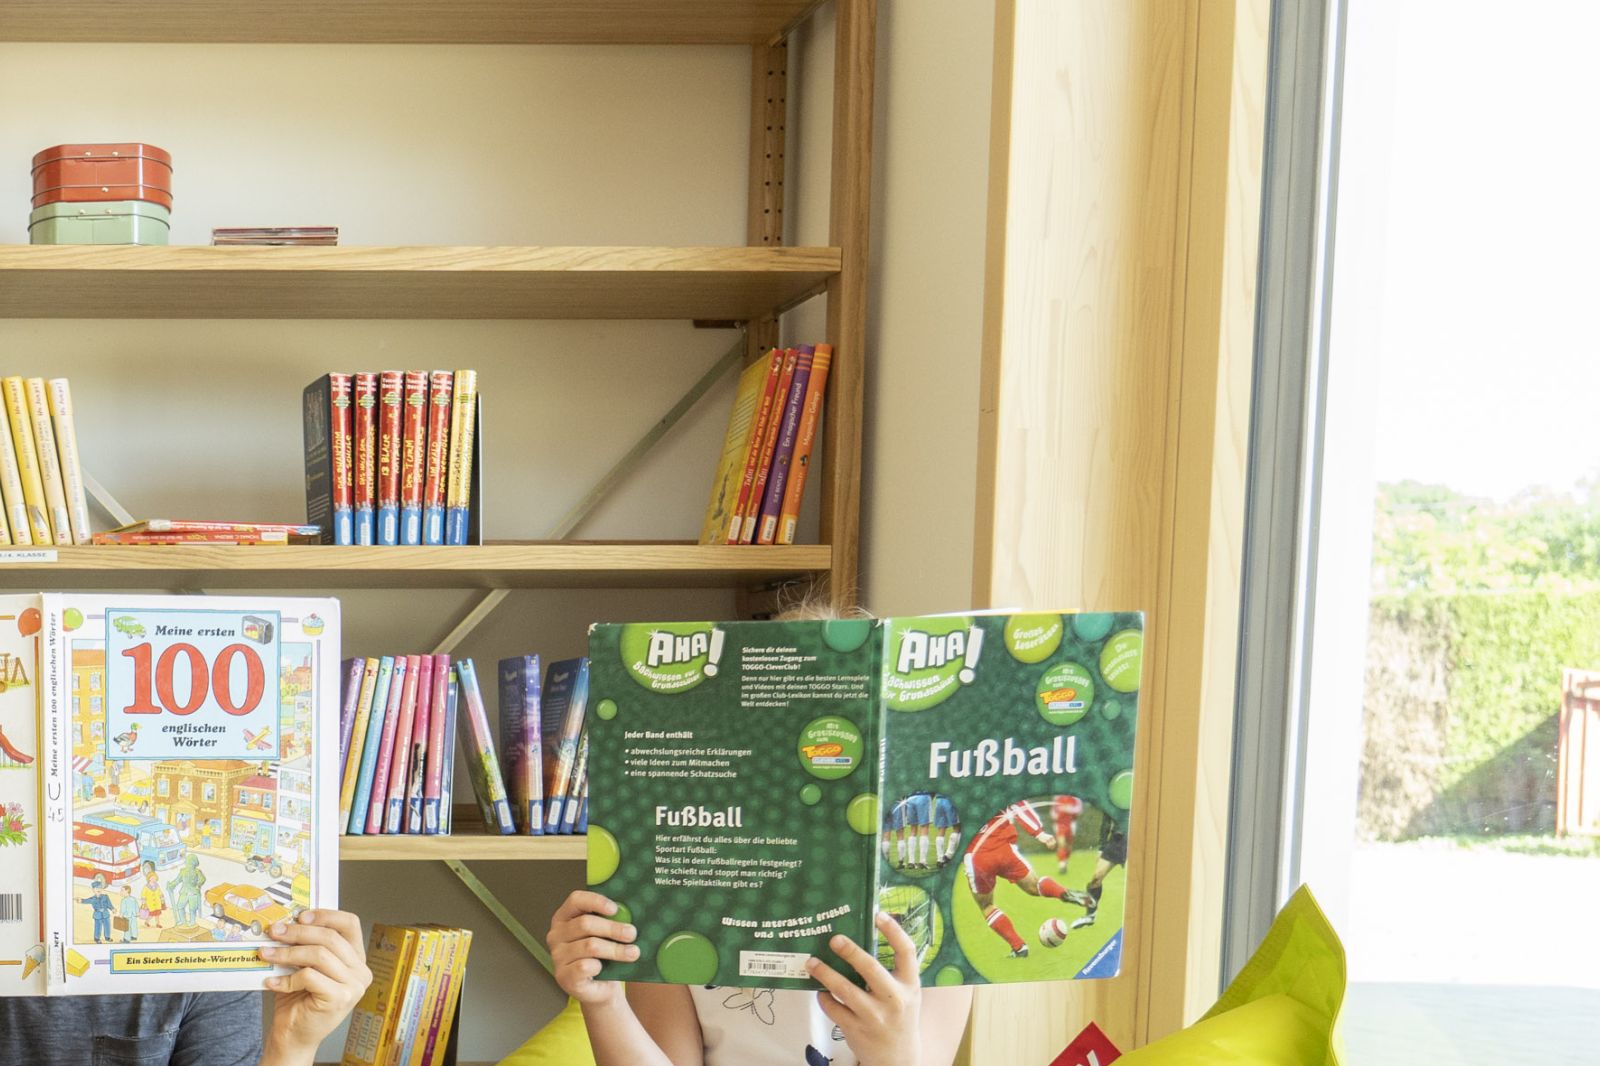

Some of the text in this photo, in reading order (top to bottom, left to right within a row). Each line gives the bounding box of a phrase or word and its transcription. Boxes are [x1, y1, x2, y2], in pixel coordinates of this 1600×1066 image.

[786, 404, 798, 435] magischer
[792, 383, 802, 404] Freund
[155, 625, 235, 637] Meine ersten
[647, 628, 725, 676] AHA!
[897, 624, 984, 684] AHA!
[121, 642, 265, 716] 100
[162, 723, 226, 734] englischen
[624, 731, 644, 739] Jeder
[173, 737, 218, 747] Wörter
[630, 748, 752, 757] abwechslungsreiche Erklärungen
[928, 735, 1077, 779] Fußball
[648, 770, 689, 778] spannende
[690, 770, 736, 778] Schatzsuche
[656, 806, 742, 828] Fußball
[734, 836, 751, 844] über
[655, 845, 717, 854] Sportart Fußball:
[707, 858, 758, 867] Fußballregeln
[759, 859, 802, 868] festgelegt?
[714, 869, 739, 877] stoppt
[758, 871, 787, 879] richtig?
[682, 878, 731, 887] Spieltaktiken
[721, 904, 851, 928] Wissen interaktiv erleben
[779, 924, 832, 938] verstehen!
[143, 956, 173, 964] Siebert
[174, 955, 261, 964] Schiebe-Wörterbuch
